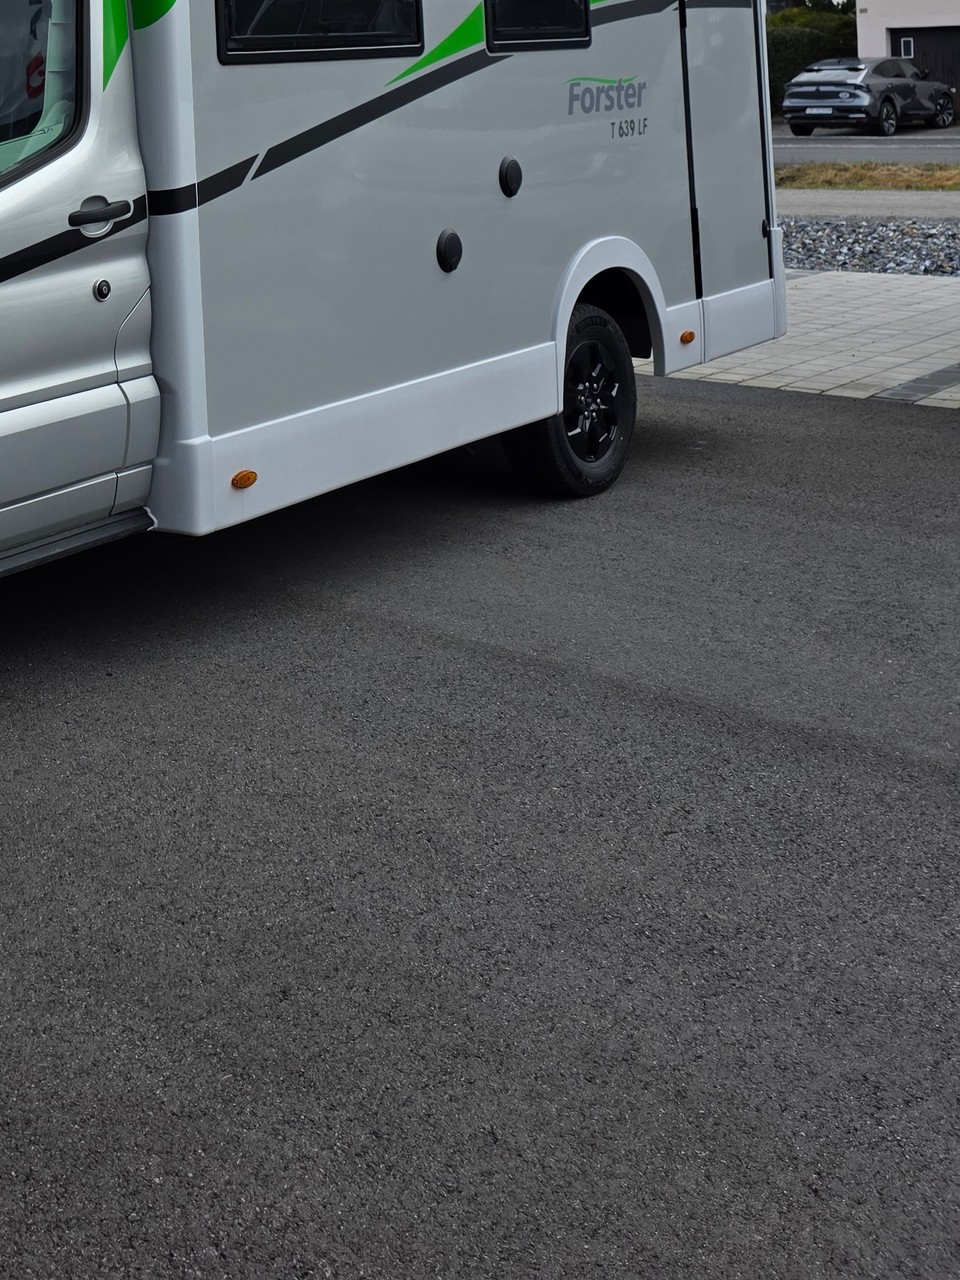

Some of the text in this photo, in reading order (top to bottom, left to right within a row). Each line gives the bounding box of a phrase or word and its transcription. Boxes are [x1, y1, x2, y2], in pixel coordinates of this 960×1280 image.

[567, 78, 647, 115] Forster
[610, 118, 648, 139] T 639 LF
